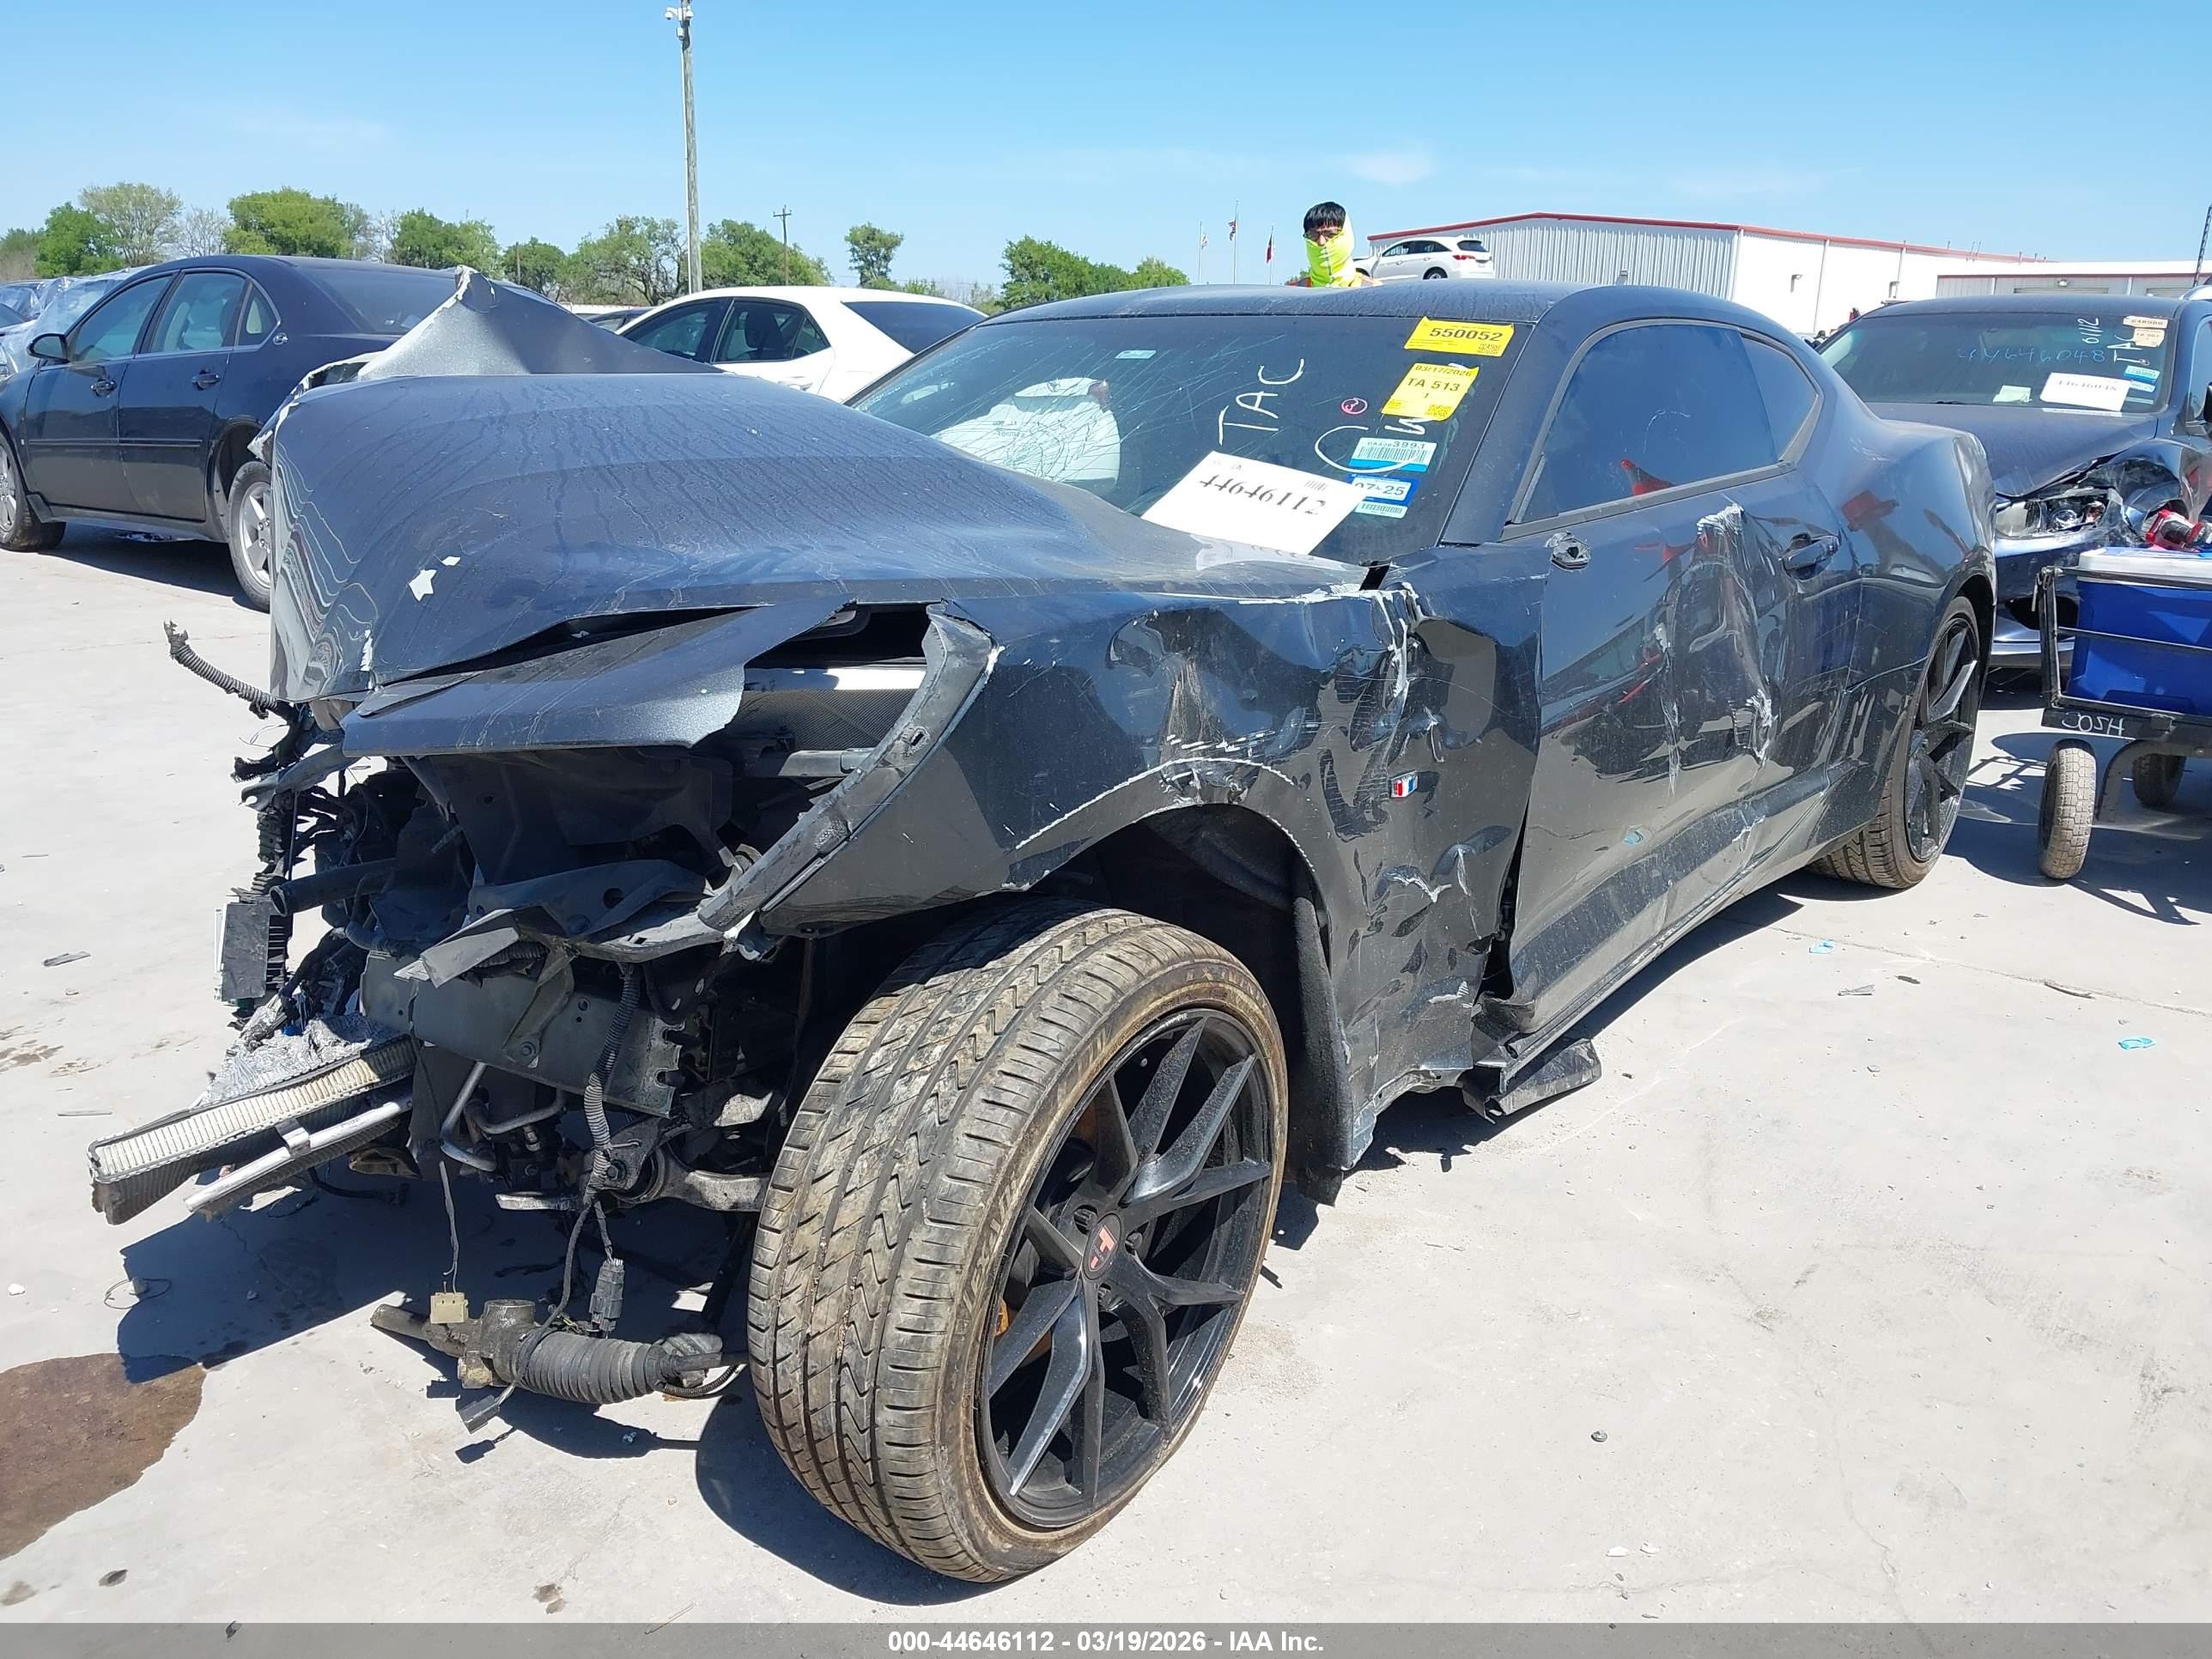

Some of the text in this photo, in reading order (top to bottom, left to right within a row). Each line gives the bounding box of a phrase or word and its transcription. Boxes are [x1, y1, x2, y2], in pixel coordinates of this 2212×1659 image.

[1430, 327, 1504, 342] 550052
[1415, 365, 1474, 377] 03/17/2026
[1407, 378, 1461, 392] TA 513
[1218, 358, 1304, 446] TAC
[1200, 474, 1327, 515] 44646112
[1382, 485, 1406, 496] 25
